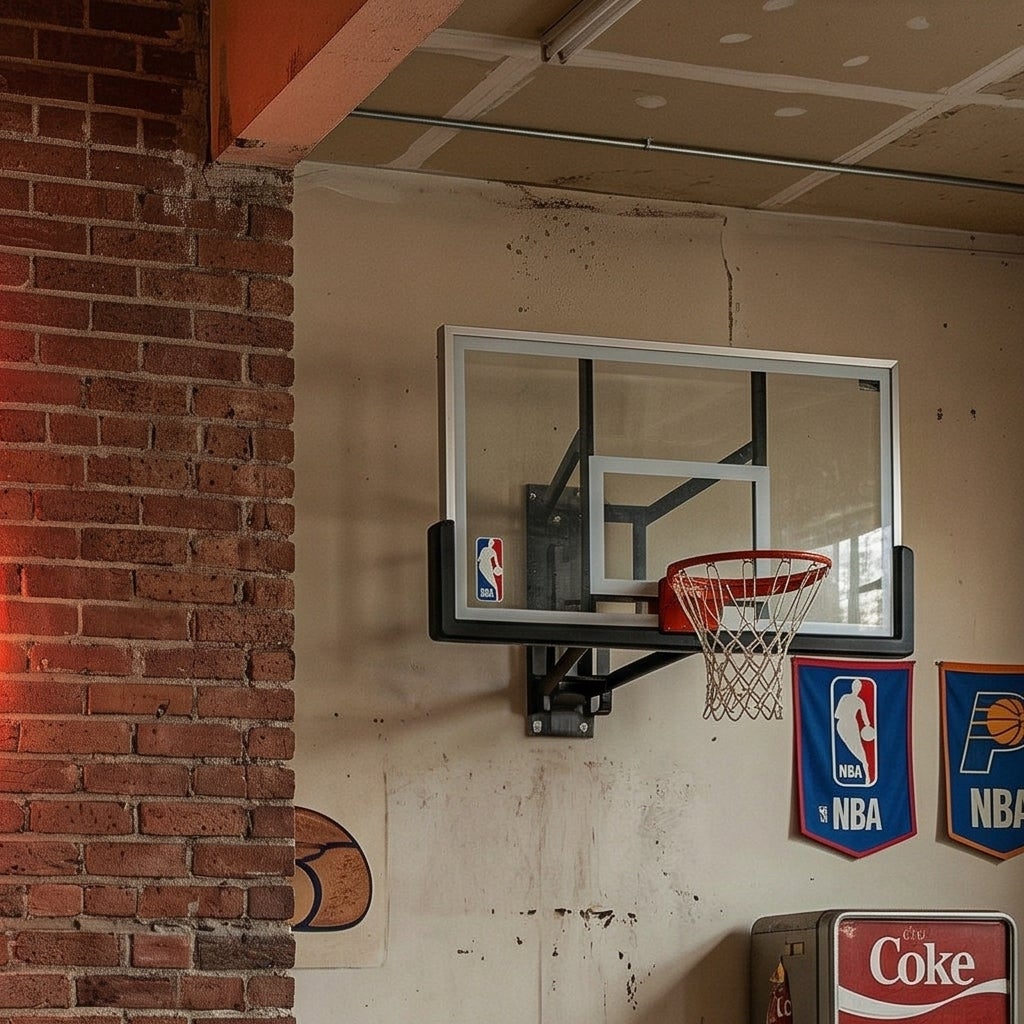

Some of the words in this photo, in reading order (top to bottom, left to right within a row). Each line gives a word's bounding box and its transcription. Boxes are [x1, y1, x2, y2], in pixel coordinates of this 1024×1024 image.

[839, 764, 863, 779] NBA
[833, 797, 883, 831] NBA
[869, 936, 976, 986] Coke
